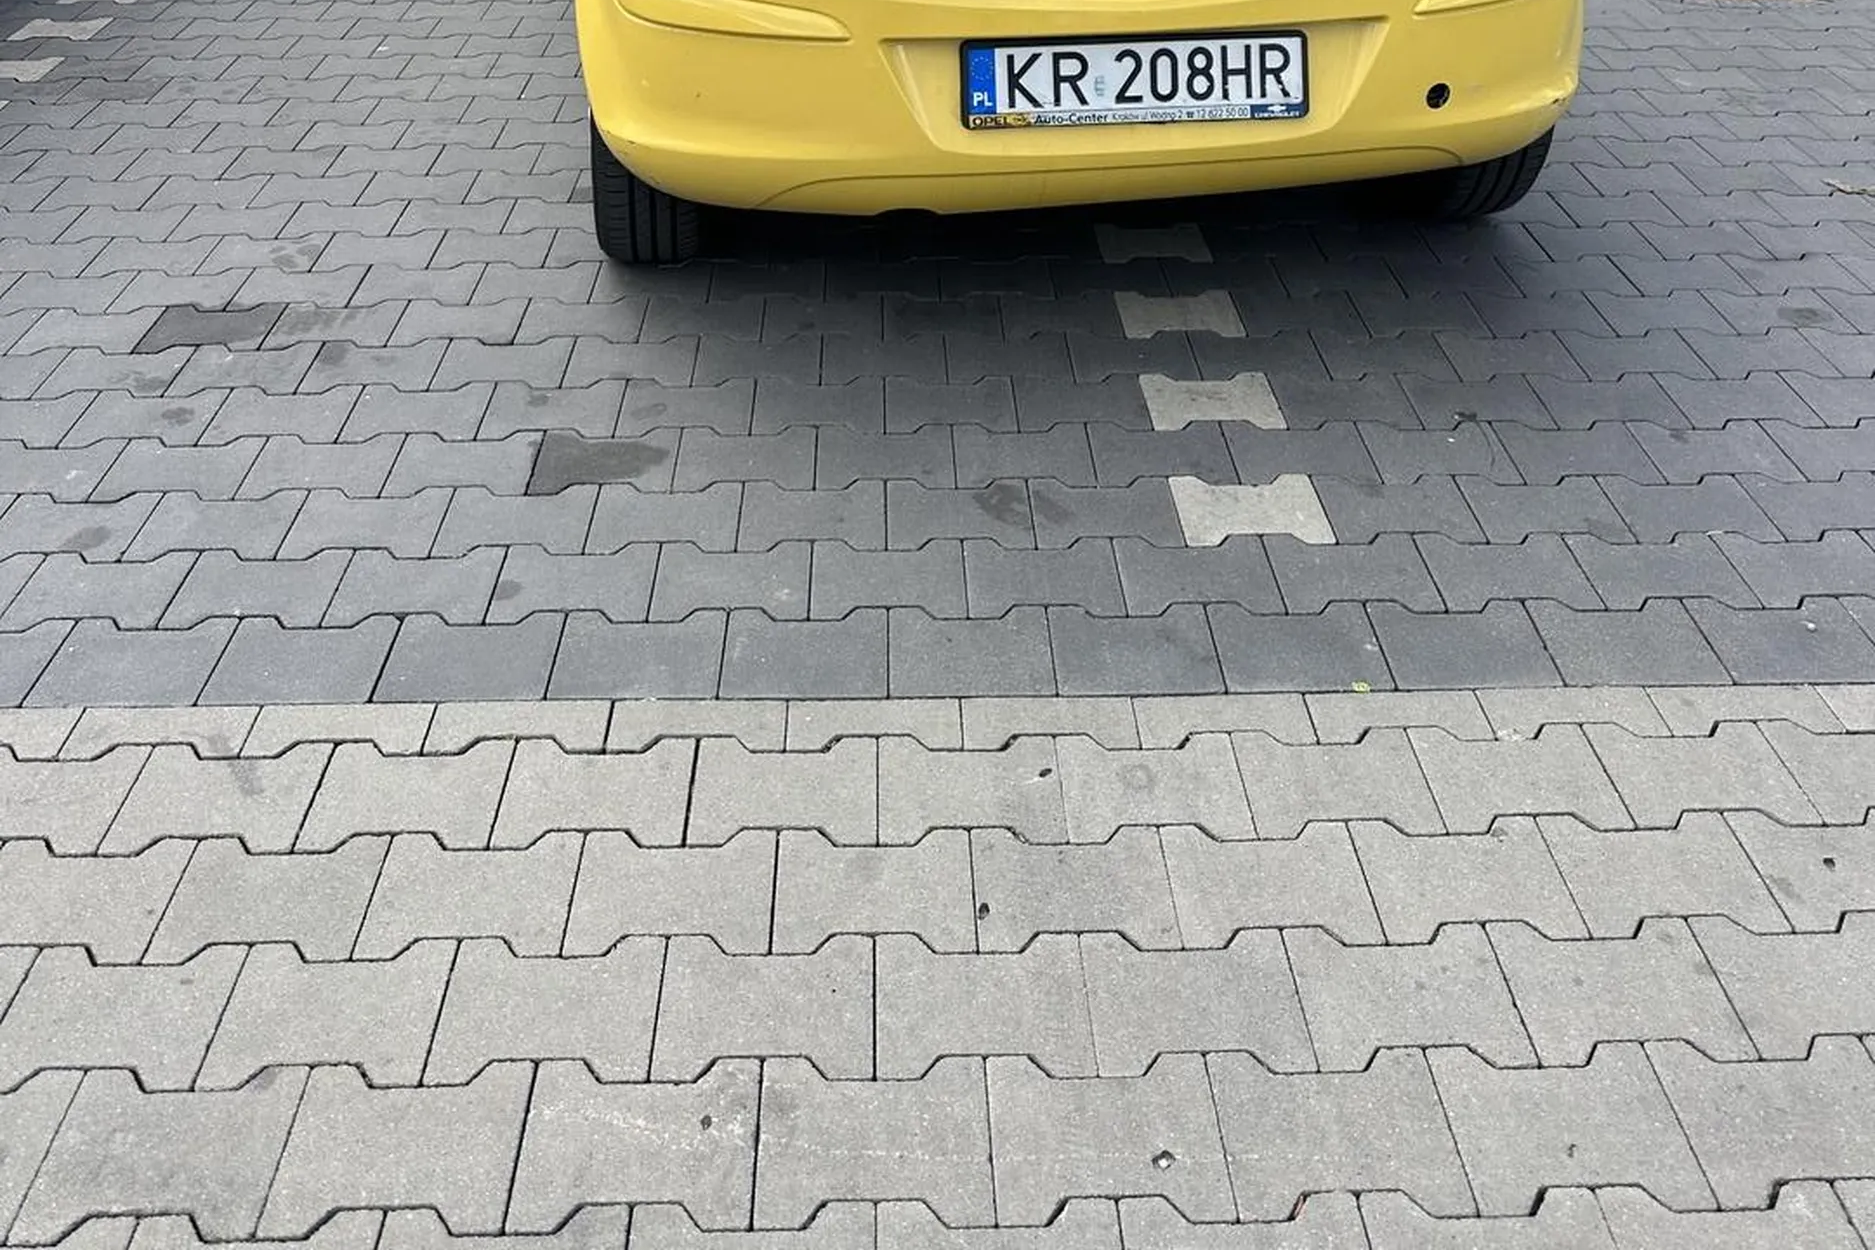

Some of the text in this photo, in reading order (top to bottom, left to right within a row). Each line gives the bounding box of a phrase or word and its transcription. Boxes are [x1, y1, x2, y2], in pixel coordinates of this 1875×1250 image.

[1006, 43, 1292, 108] KR 208HR
[973, 92, 993, 106] PL
[972, 115, 1008, 126] OPEL
[1034, 113, 1108, 125] Auto-Center
[1225, 106, 1237, 117] 50
[1237, 105, 1249, 117] 00
